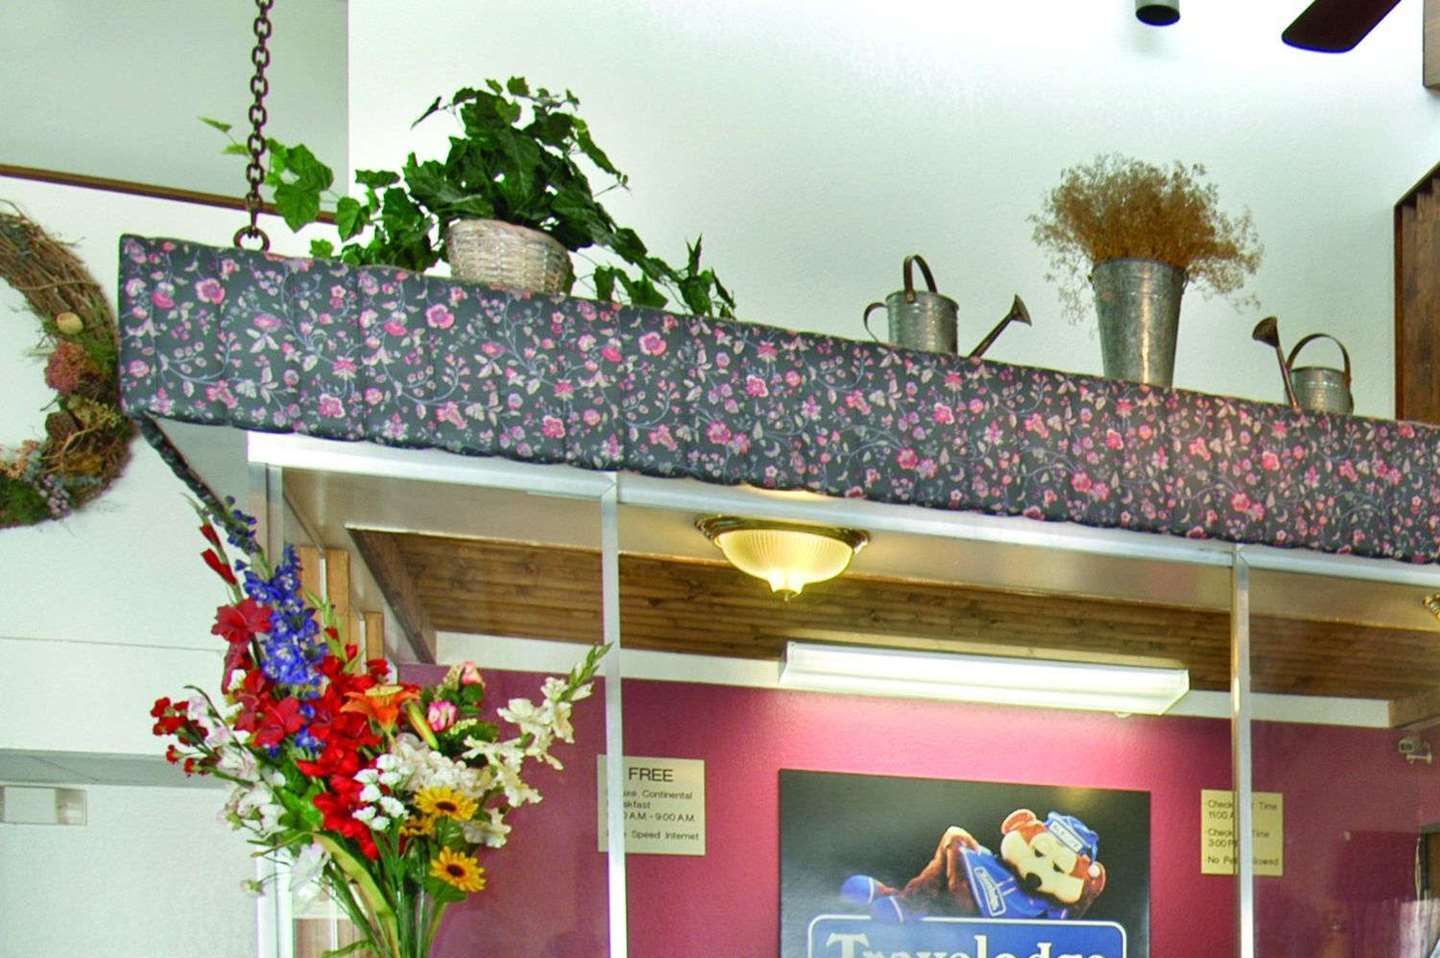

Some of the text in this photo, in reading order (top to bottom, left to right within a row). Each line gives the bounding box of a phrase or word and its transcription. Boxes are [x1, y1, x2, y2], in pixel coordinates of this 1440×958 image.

[628, 767, 674, 783] FREE
[642, 790, 693, 799] Continental
[631, 830, 661, 840] Speed
[665, 831, 700, 841] Internet
[1207, 856, 1220, 865] No
